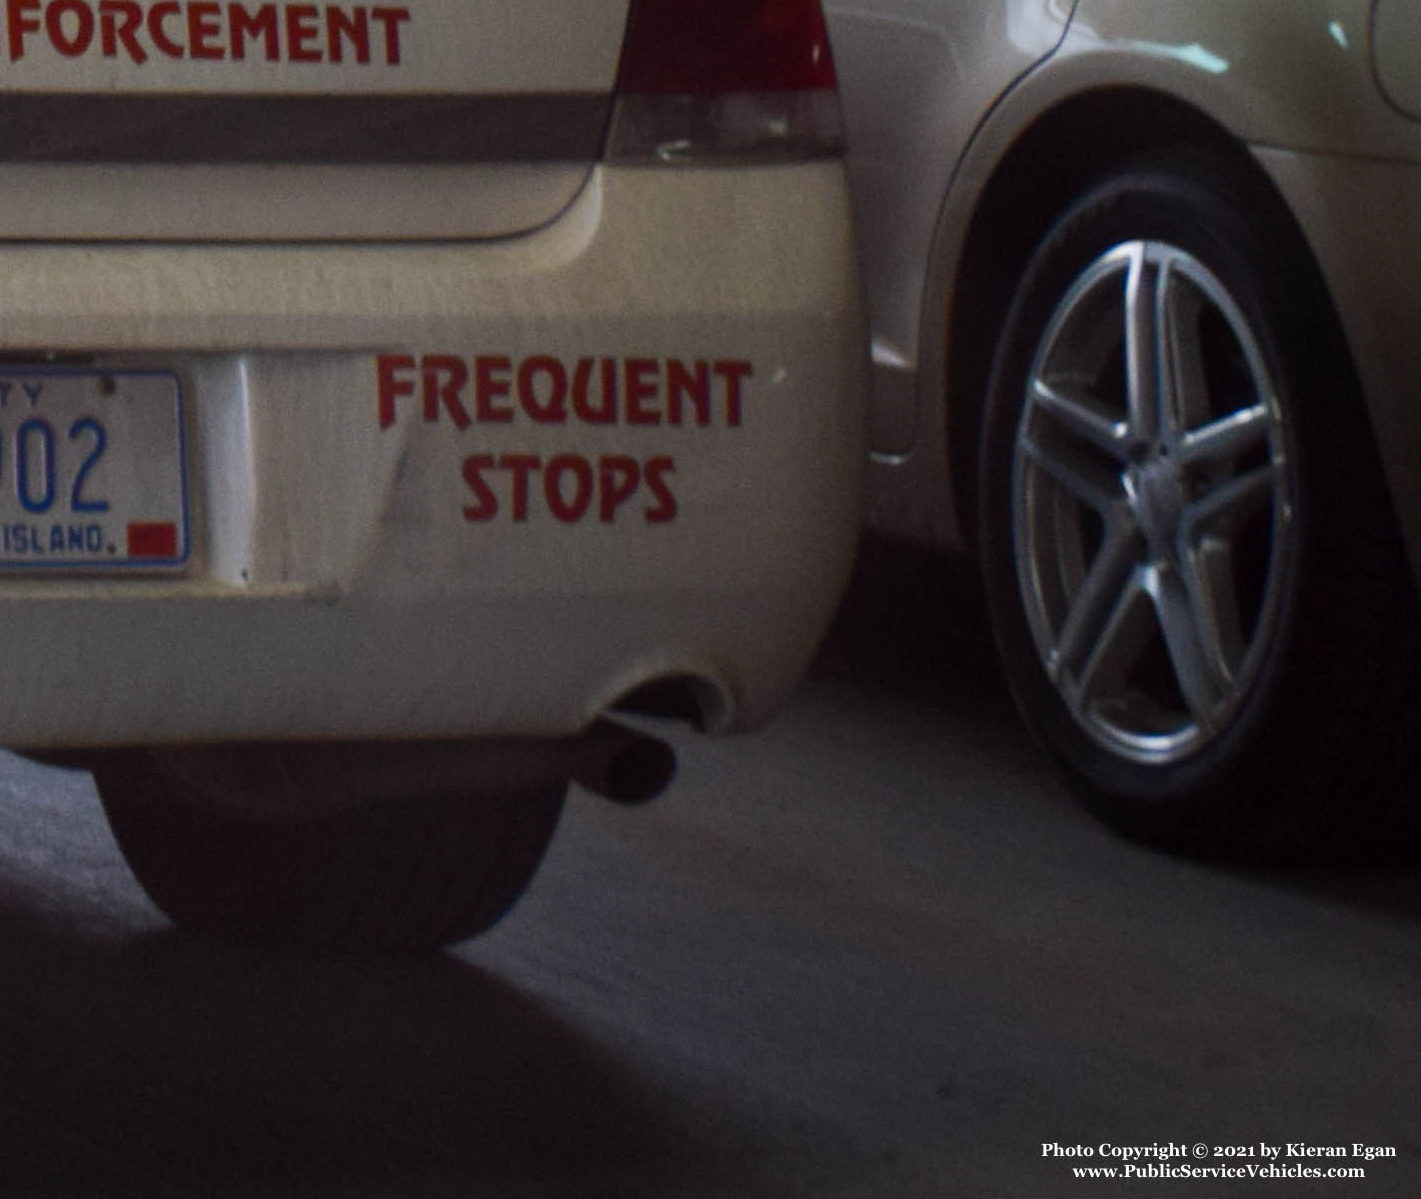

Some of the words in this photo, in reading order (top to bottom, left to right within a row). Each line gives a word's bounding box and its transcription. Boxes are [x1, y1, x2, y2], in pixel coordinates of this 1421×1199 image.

[375, 353, 754, 432] FREQUENT
[461, 452, 678, 524] STOPS
[3, 523, 103, 553] ISLAND
